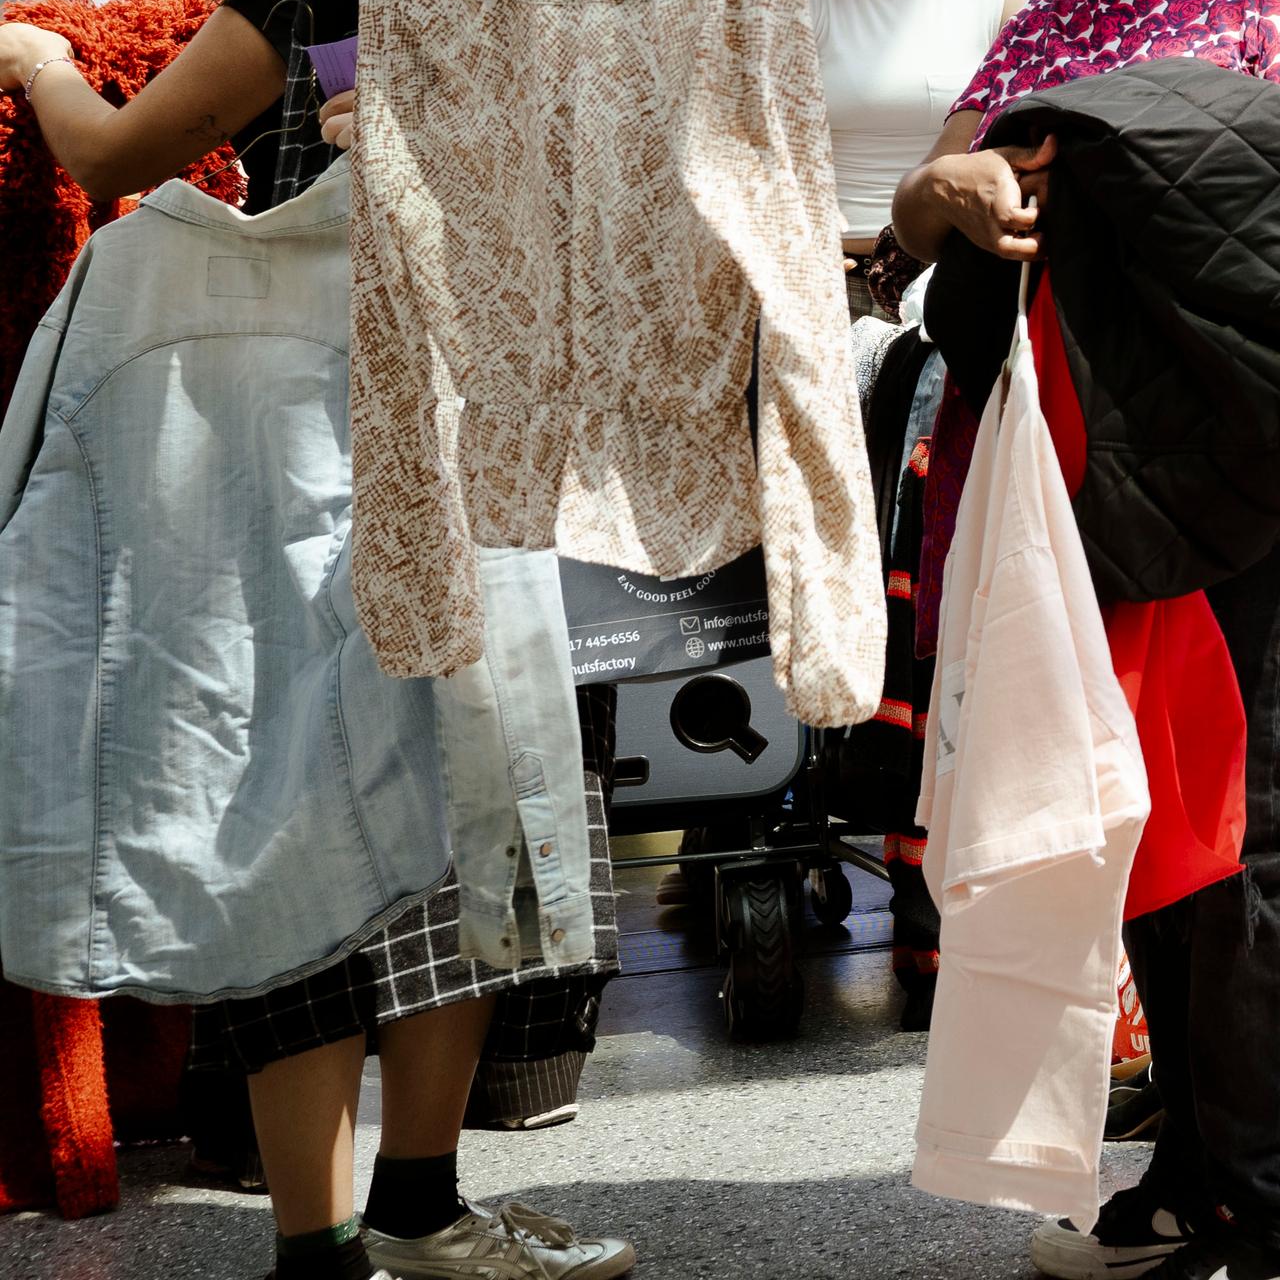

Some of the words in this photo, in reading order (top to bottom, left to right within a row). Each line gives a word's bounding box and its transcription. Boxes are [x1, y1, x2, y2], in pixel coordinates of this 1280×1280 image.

[617, 574, 637, 594] EAT
[636, 589, 668, 603] GOOD
[670, 587, 697, 602] FEEL
[585, 630, 641, 648] 445-6556
